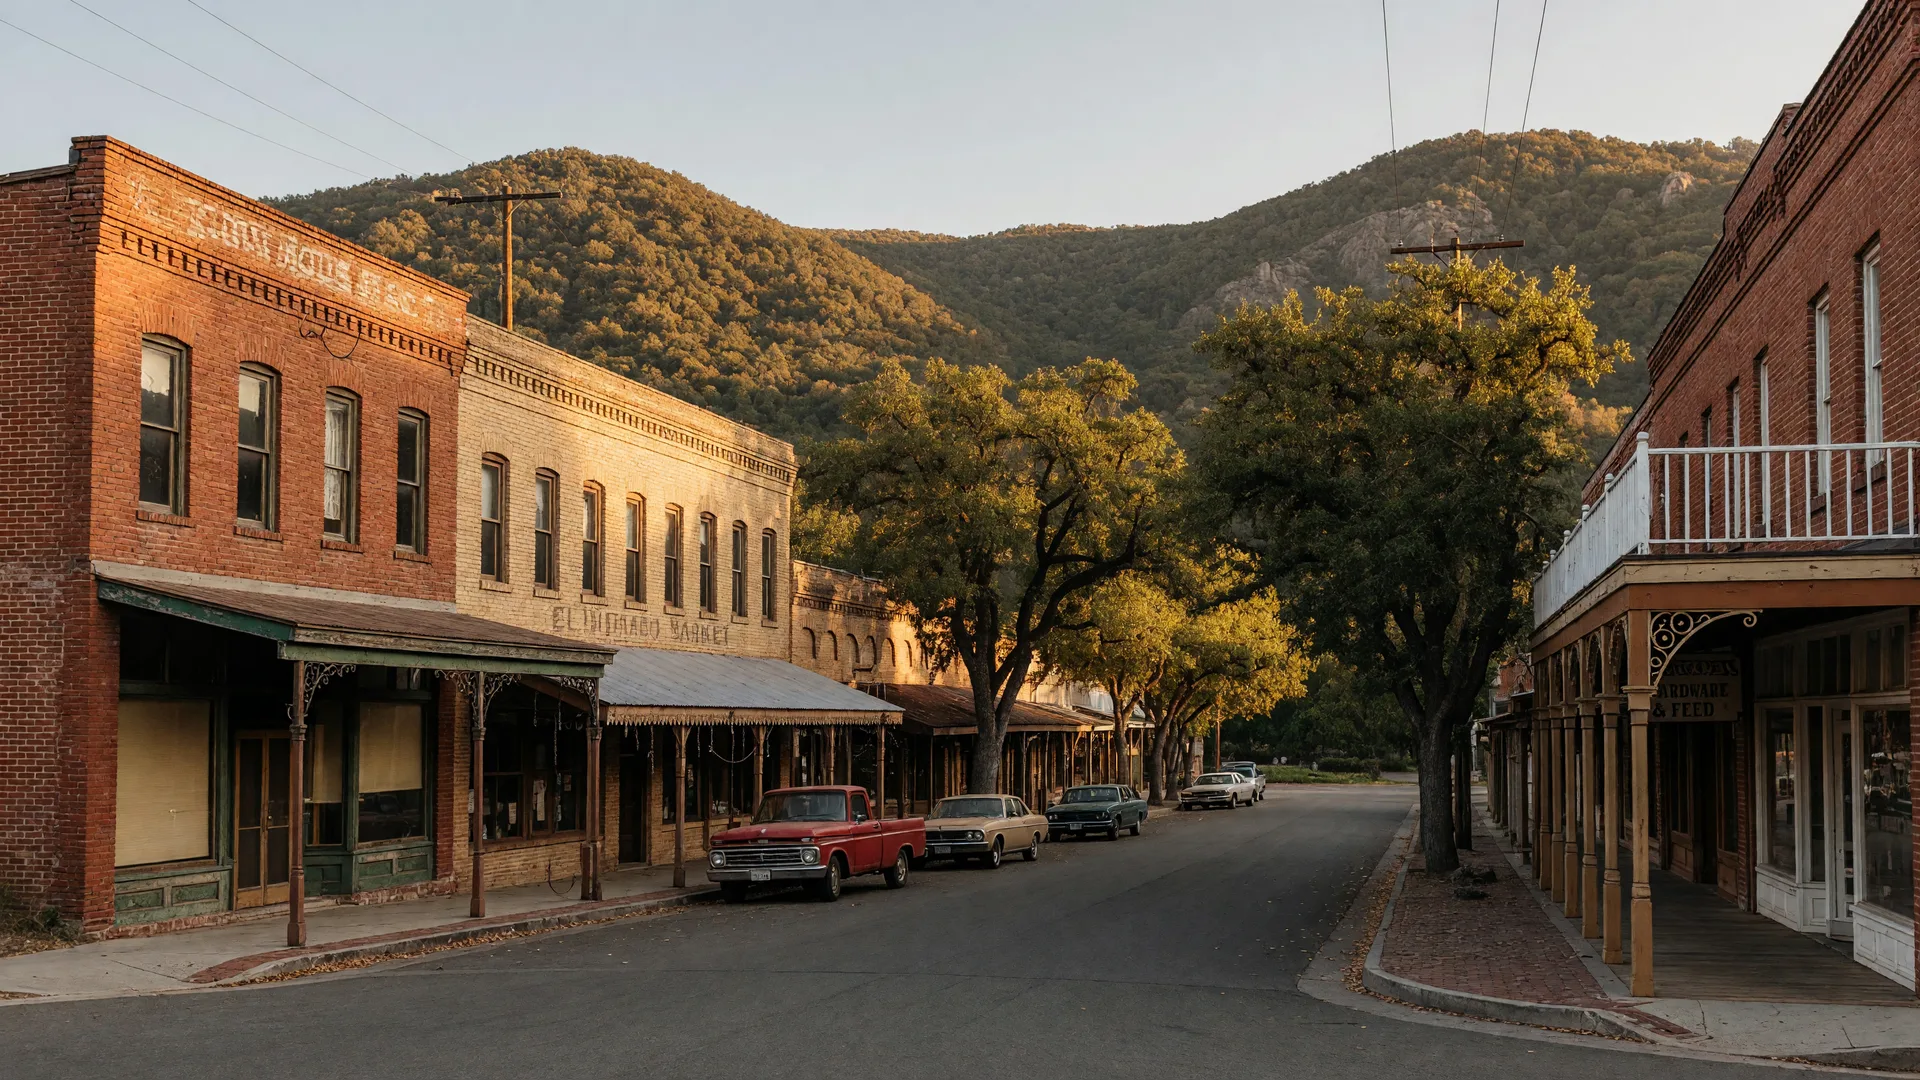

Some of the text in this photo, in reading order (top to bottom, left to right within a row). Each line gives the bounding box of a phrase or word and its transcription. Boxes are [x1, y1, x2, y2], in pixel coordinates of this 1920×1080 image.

[1658, 682, 1729, 698] ARDWARE
[1652, 702, 1715, 718] & FEED
